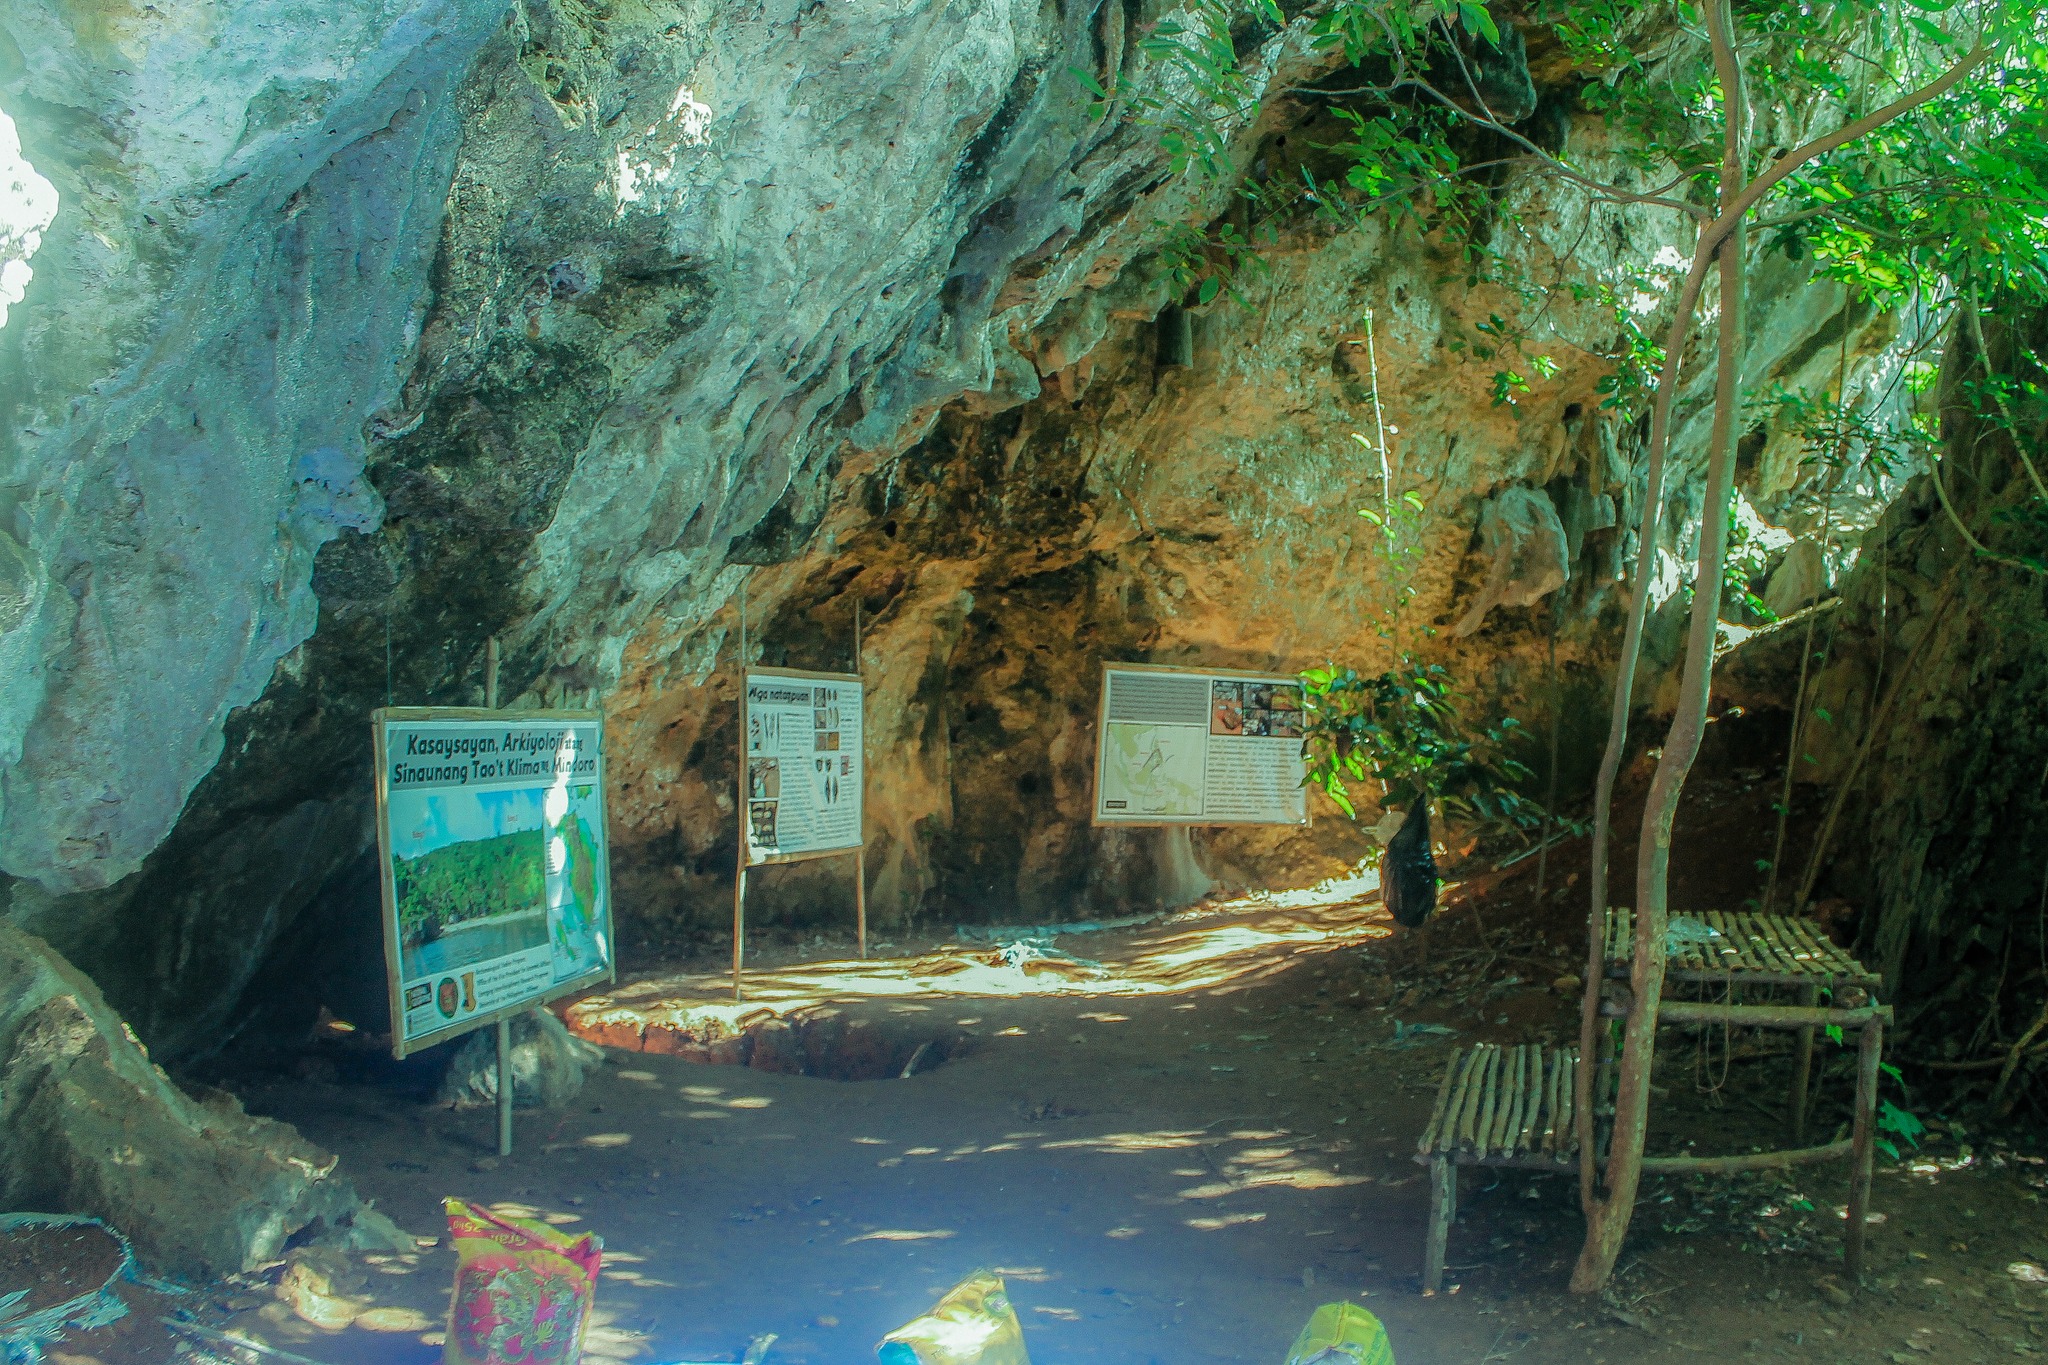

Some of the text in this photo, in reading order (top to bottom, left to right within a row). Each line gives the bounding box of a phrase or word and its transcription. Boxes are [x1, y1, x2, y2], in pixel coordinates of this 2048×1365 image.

[407, 734, 498, 759] Kasaysayan,
[502, 731, 564, 756] Arkiyoloji
[394, 763, 468, 784] Sinaunang
[472, 759, 503, 778] Tao't
[507, 758, 540, 776] Klima
[552, 756, 595, 773] Mindoro
